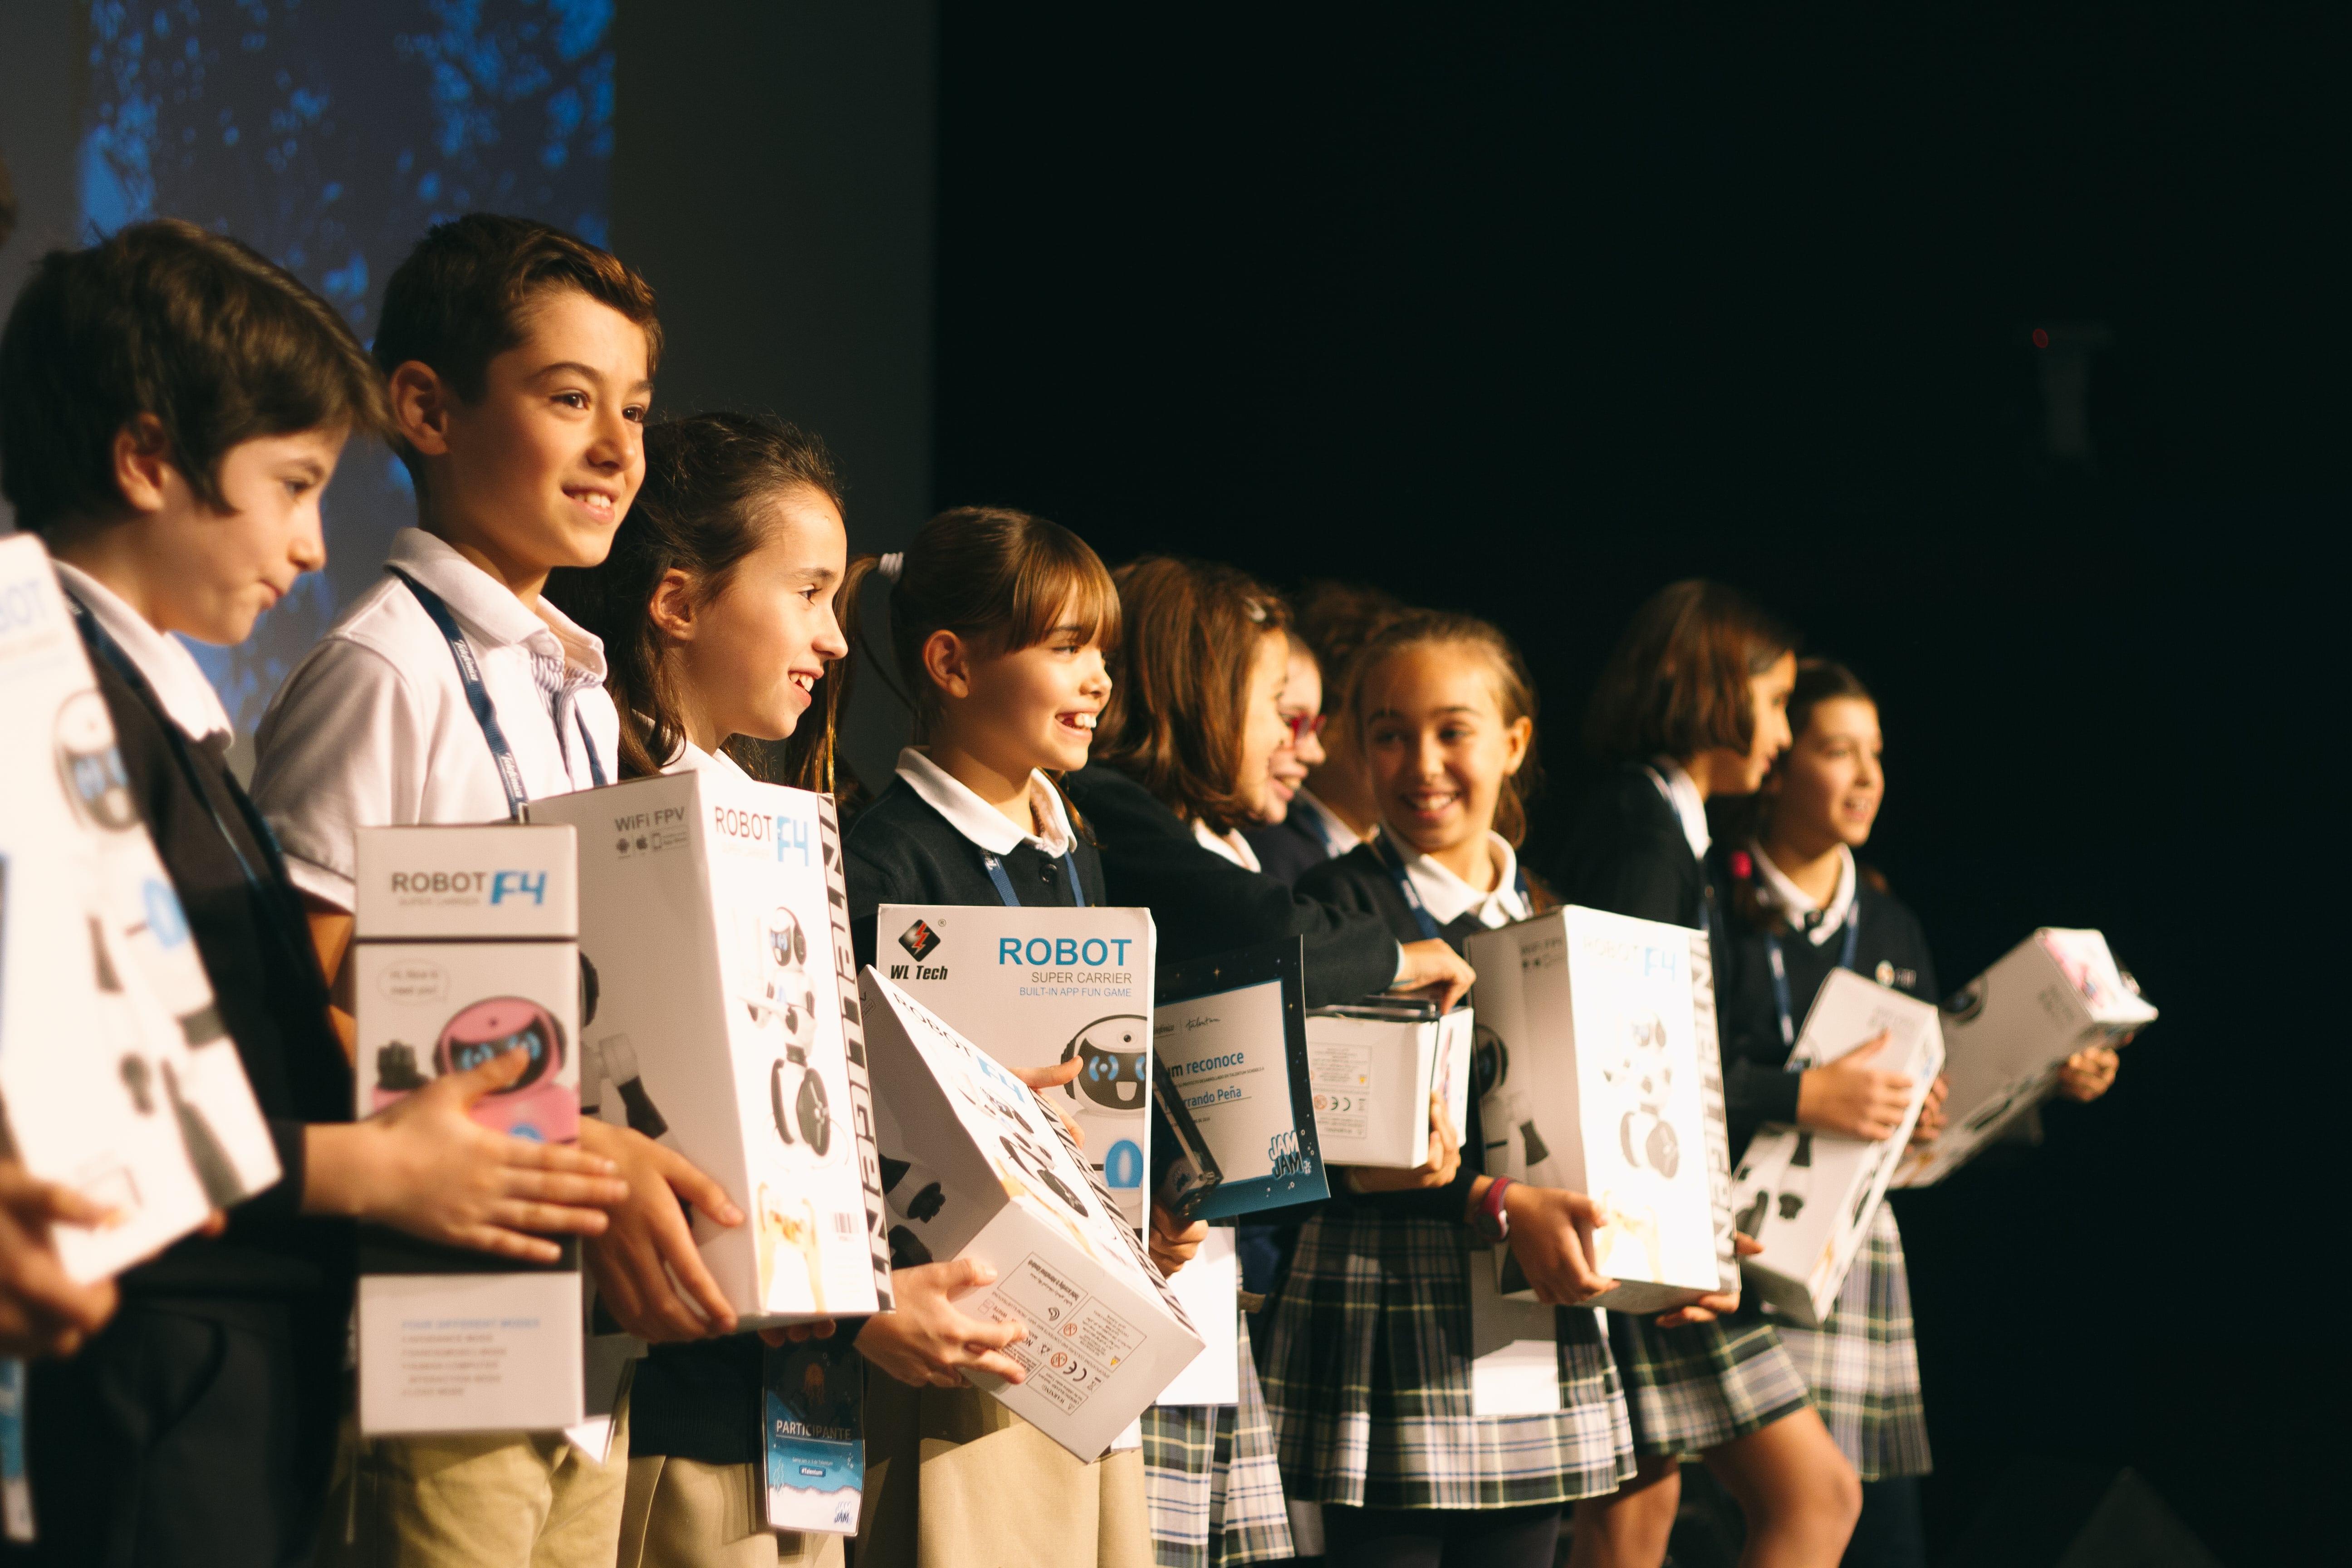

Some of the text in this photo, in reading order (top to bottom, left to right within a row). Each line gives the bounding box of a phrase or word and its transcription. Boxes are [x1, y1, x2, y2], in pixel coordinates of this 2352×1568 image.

[654, 806, 684, 825] FPV
[715, 806, 771, 842] ROBOT
[777, 815, 809, 867] F4
[392, 870, 546, 906] ROBOT F4
[999, 938, 1132, 966] ROBOT
[891, 965, 948, 980] WL Tech
[1645, 947, 1676, 982] F4
[1031, 972, 1132, 984] SUPER CARRIER
[1019, 987, 1132, 997] BUILT-IN APP FUN GAME
[893, 992, 1026, 1104] ROBOT F4
[1186, 1052, 1245, 1073] reconoce
[1183, 1085, 1242, 1107] rrando Peña
[1269, 1132, 1299, 1161] JAM
[1273, 1152, 1304, 1179] JAM
[776, 1419, 851, 1440] PARTICIPANTE
[836, 1501, 851, 1514] JAM
[834, 1513, 849, 1524] JAM
